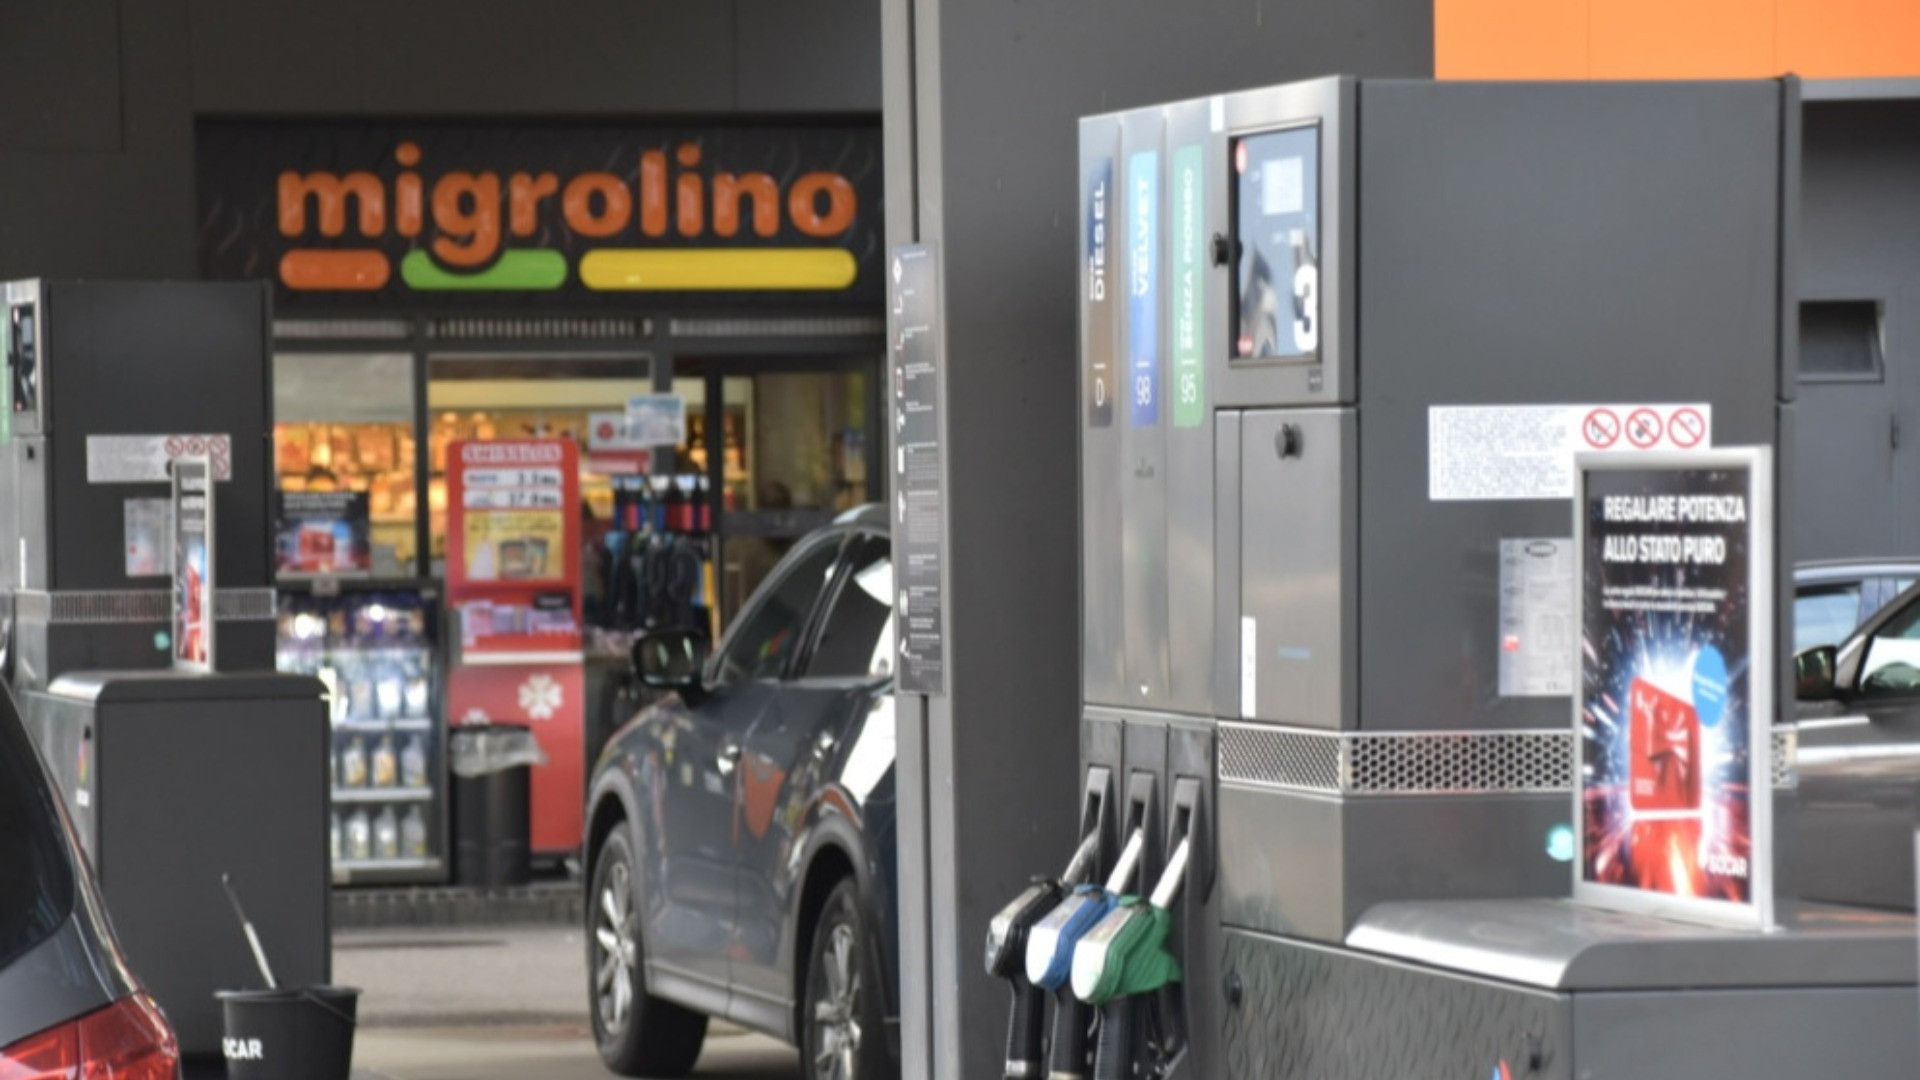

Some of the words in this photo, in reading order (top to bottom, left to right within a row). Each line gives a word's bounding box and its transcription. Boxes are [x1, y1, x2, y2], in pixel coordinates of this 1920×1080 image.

[278, 143, 857, 266] migrolino
[1094, 180, 1105, 301] DIESEL
[1138, 175, 1149, 297] VELVET
[1183, 166, 1194, 264] PIOMBO
[1294, 264, 1318, 352] 3
[1604, 496, 1675, 521] REGALARE
[1678, 496, 1746, 521] POTENZA
[1604, 536, 1637, 562] ALLO
[1639, 536, 1681, 562] STATO
[1683, 537, 1725, 564] PURO
